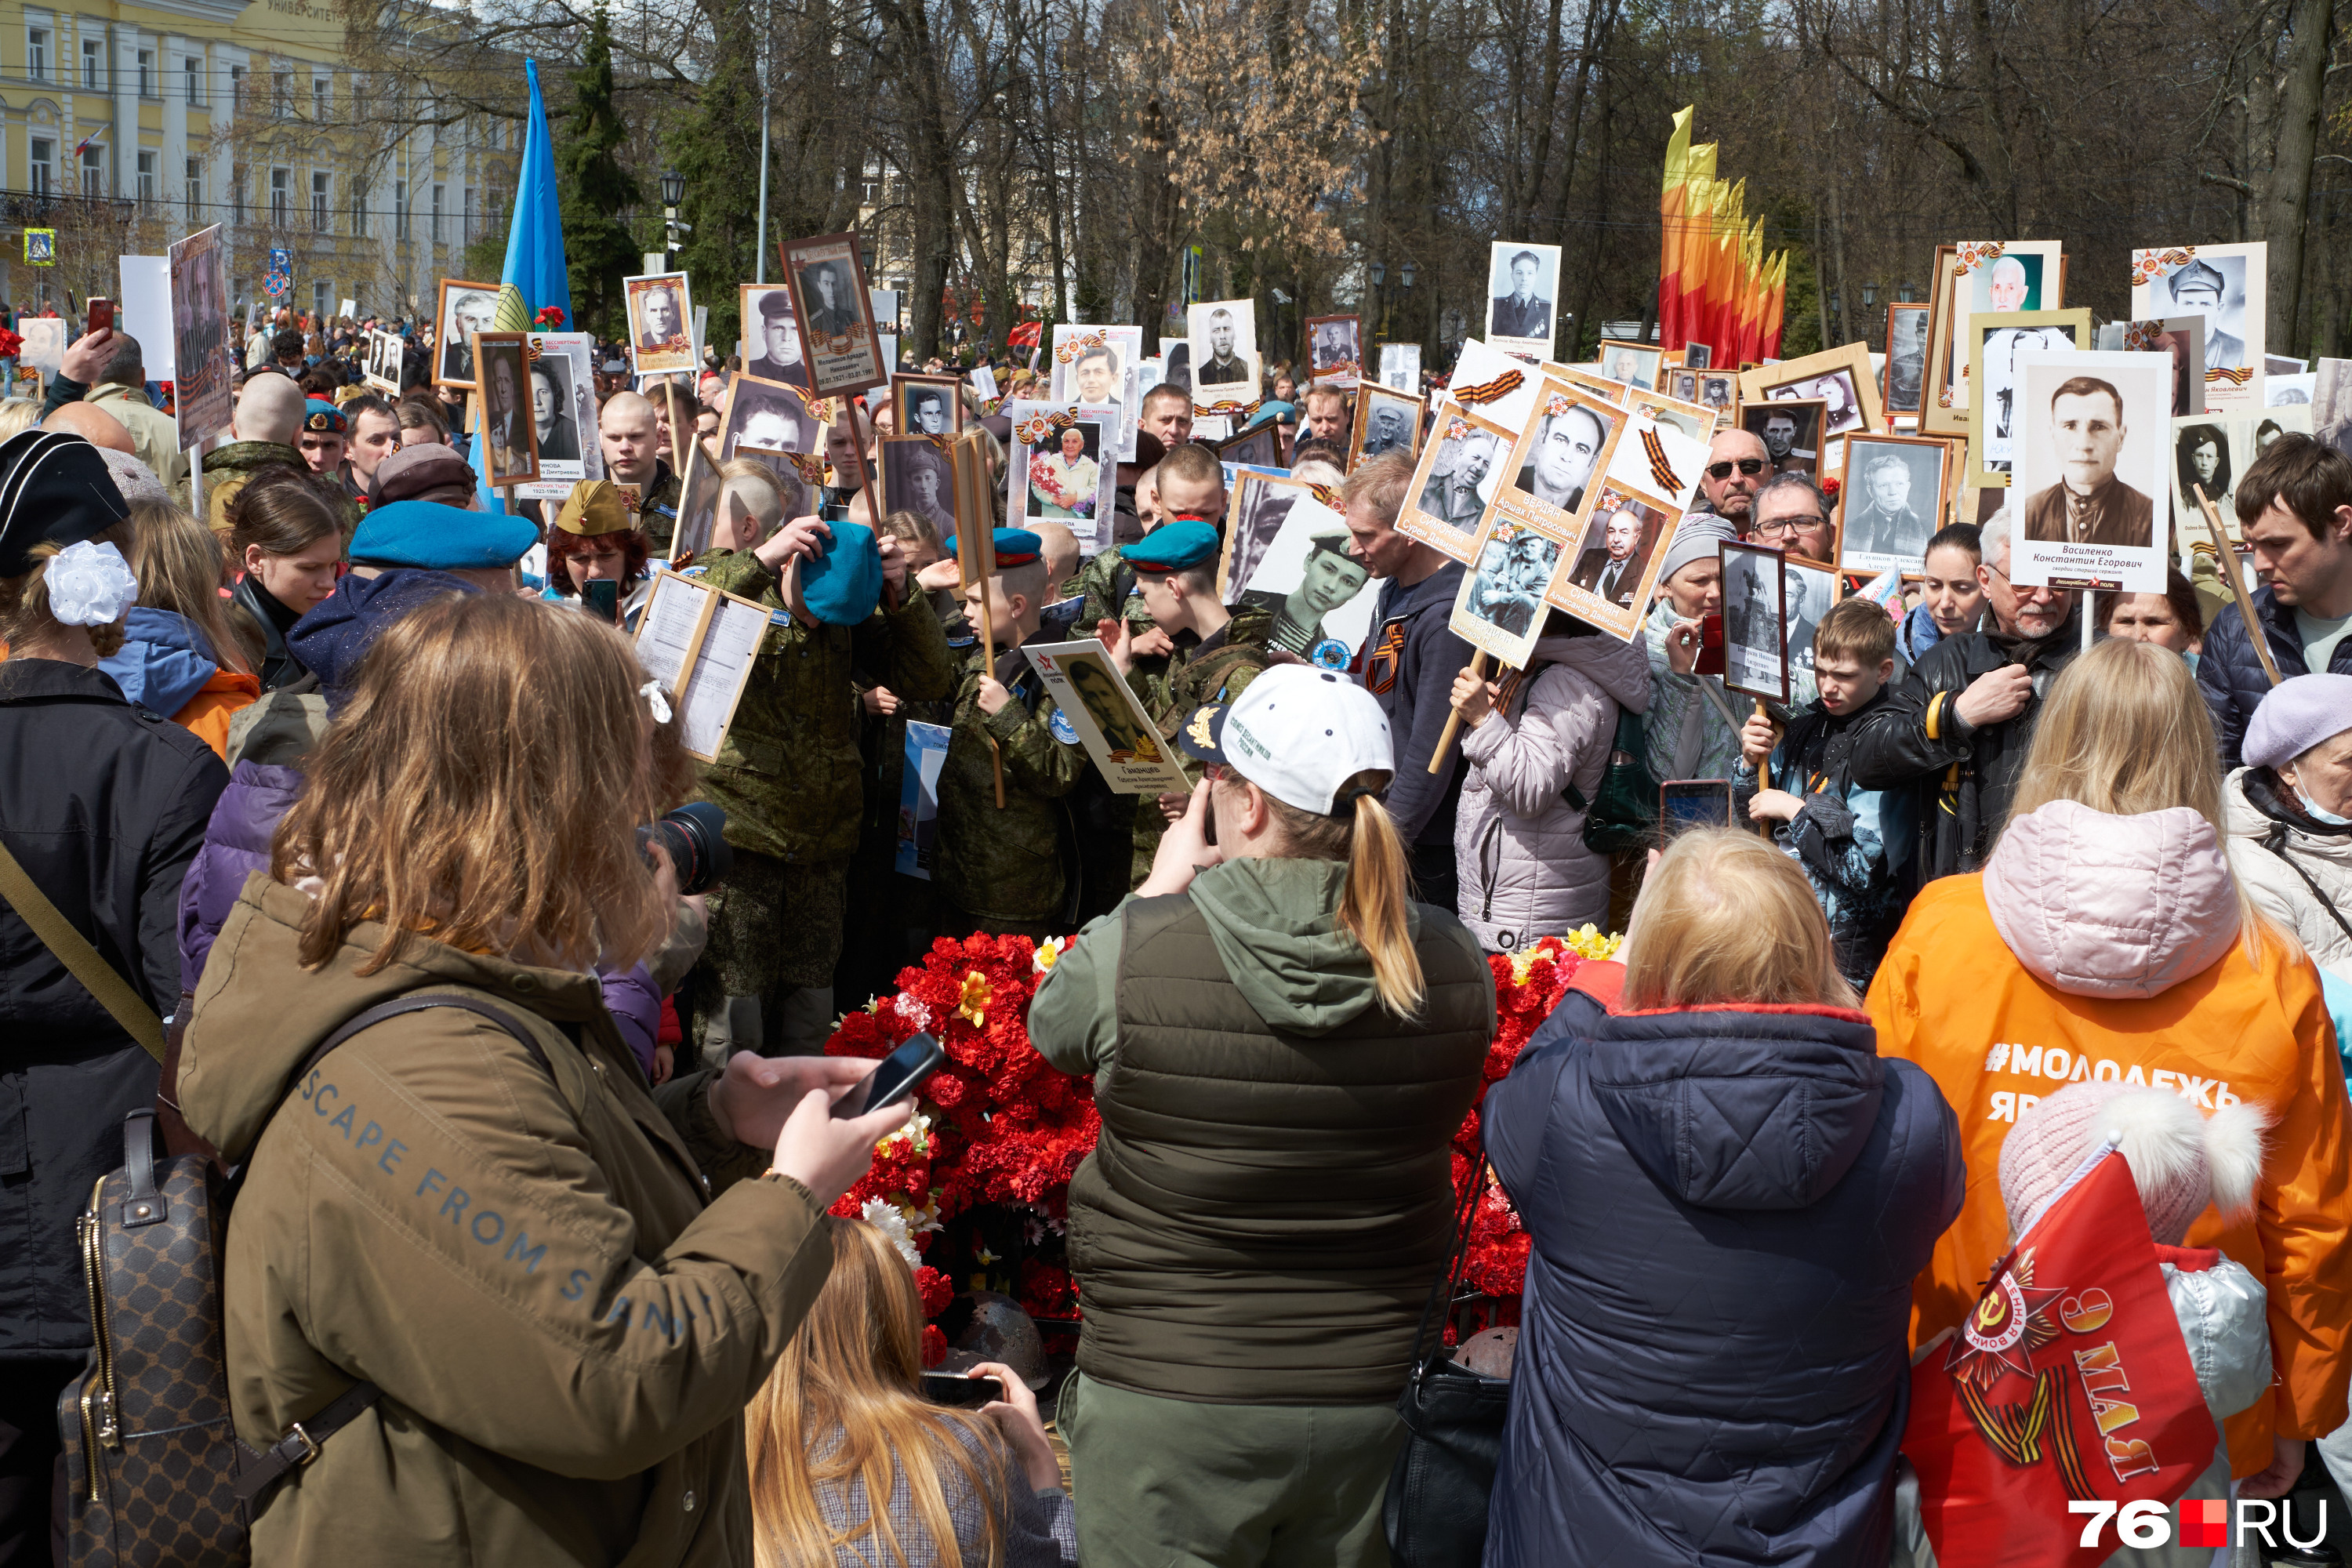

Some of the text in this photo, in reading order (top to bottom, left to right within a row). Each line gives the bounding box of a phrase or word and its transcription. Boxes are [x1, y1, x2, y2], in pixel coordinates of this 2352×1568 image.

[267, 0, 337, 23] УНИВЕРСИТЕТ
[818, 350, 868, 366] Мельников Аркадий
[829, 363, 860, 373] Николаевич
[818, 375, 845, 385] 09.01.1921
[848, 368, 874, 379] 03.01.1991
[1497, 495, 1578, 541] Аршак Петросович
[1523, 495, 1563, 520] ВЕРДЯН
[1402, 519, 1472, 561] Сурен Давидович
[1419, 514, 1466, 544] СИМОНЯН
[2033, 553, 2143, 569] Константин Егорович
[2062, 545, 2113, 557] Василенко
[1549, 590, 1632, 635] Александр Давидович
[1569, 587, 1621, 619] СИМОНЯН
[1450, 619, 1482, 643] Мамикон
[1470, 617, 1515, 646] ВЕРДИЯН
[1746, 658, 1769, 670] Андреевич
[1759, 652, 1778, 664] Николай
[1236, 737, 1253, 759] РОССИИ
[1243, 728, 1272, 761] ДЕСАНТНИКОВ
[1121, 765, 1160, 775] Гаманцев
[293, 1069, 409, 1177] SCAPE
[415, 1167, 548, 1275] FROM
[2003, 1273, 2024, 1338] ТВЕННАЯ
[2060, 1287, 2160, 1483] 9 МАЯ
